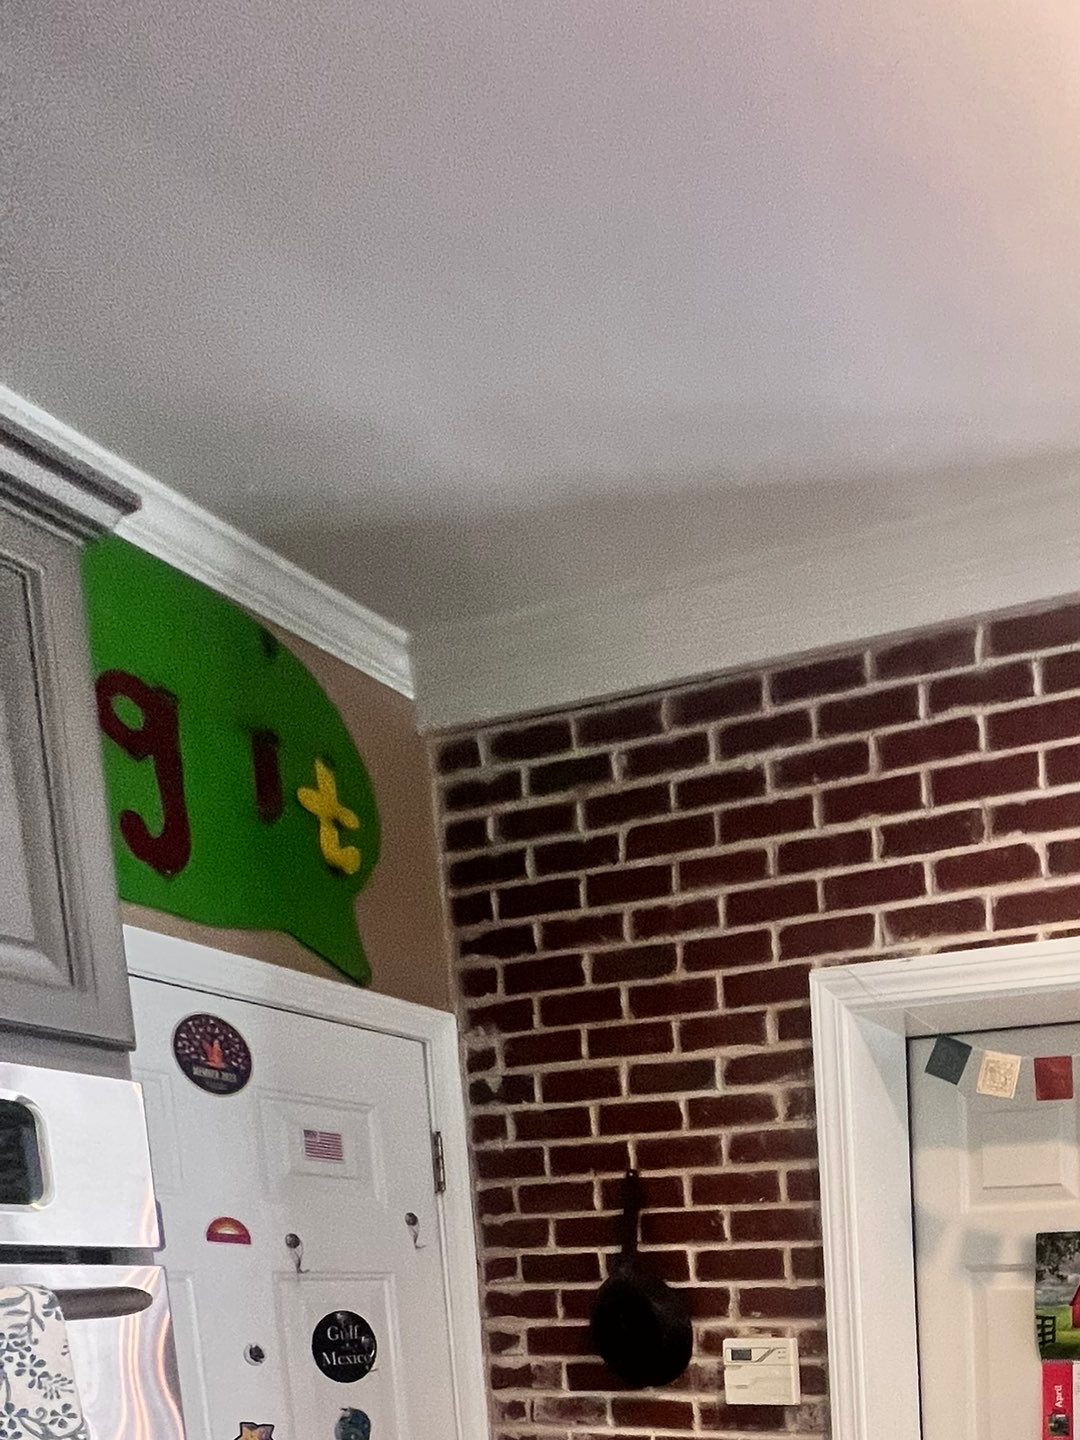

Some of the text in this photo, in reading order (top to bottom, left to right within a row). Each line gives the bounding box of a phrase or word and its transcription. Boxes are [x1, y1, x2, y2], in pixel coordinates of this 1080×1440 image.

[327, 1325, 360, 1341] Gulf
[322, 1351, 372, 1366] Mexico
[1054, 1385, 1063, 1408] April
